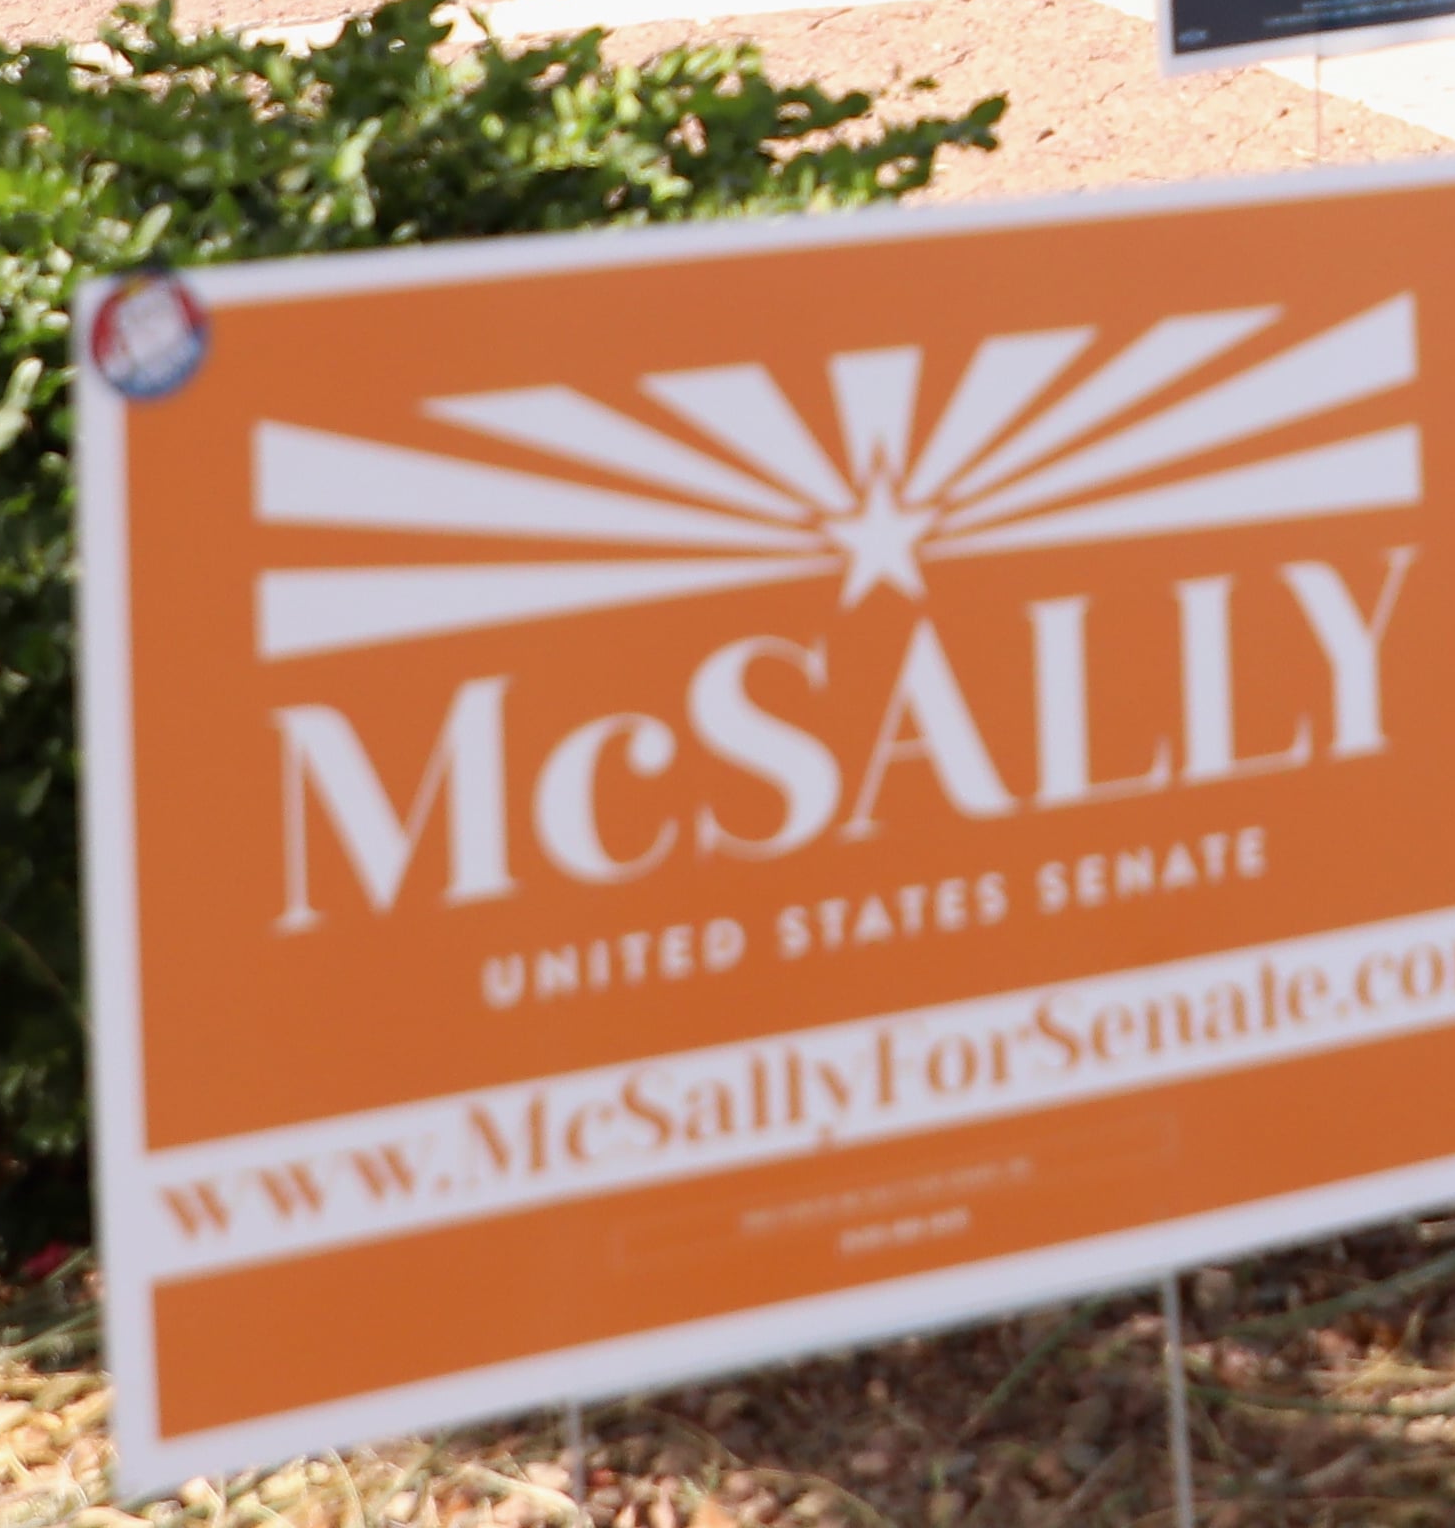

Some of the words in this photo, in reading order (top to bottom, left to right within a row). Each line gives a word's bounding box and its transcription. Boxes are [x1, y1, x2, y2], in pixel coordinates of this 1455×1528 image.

[274, 546, 1421, 936] McSALLY
[483, 912, 747, 1008] UNITED
[779, 872, 1010, 959] STATES
[1037, 827, 1267, 914] SENATE
